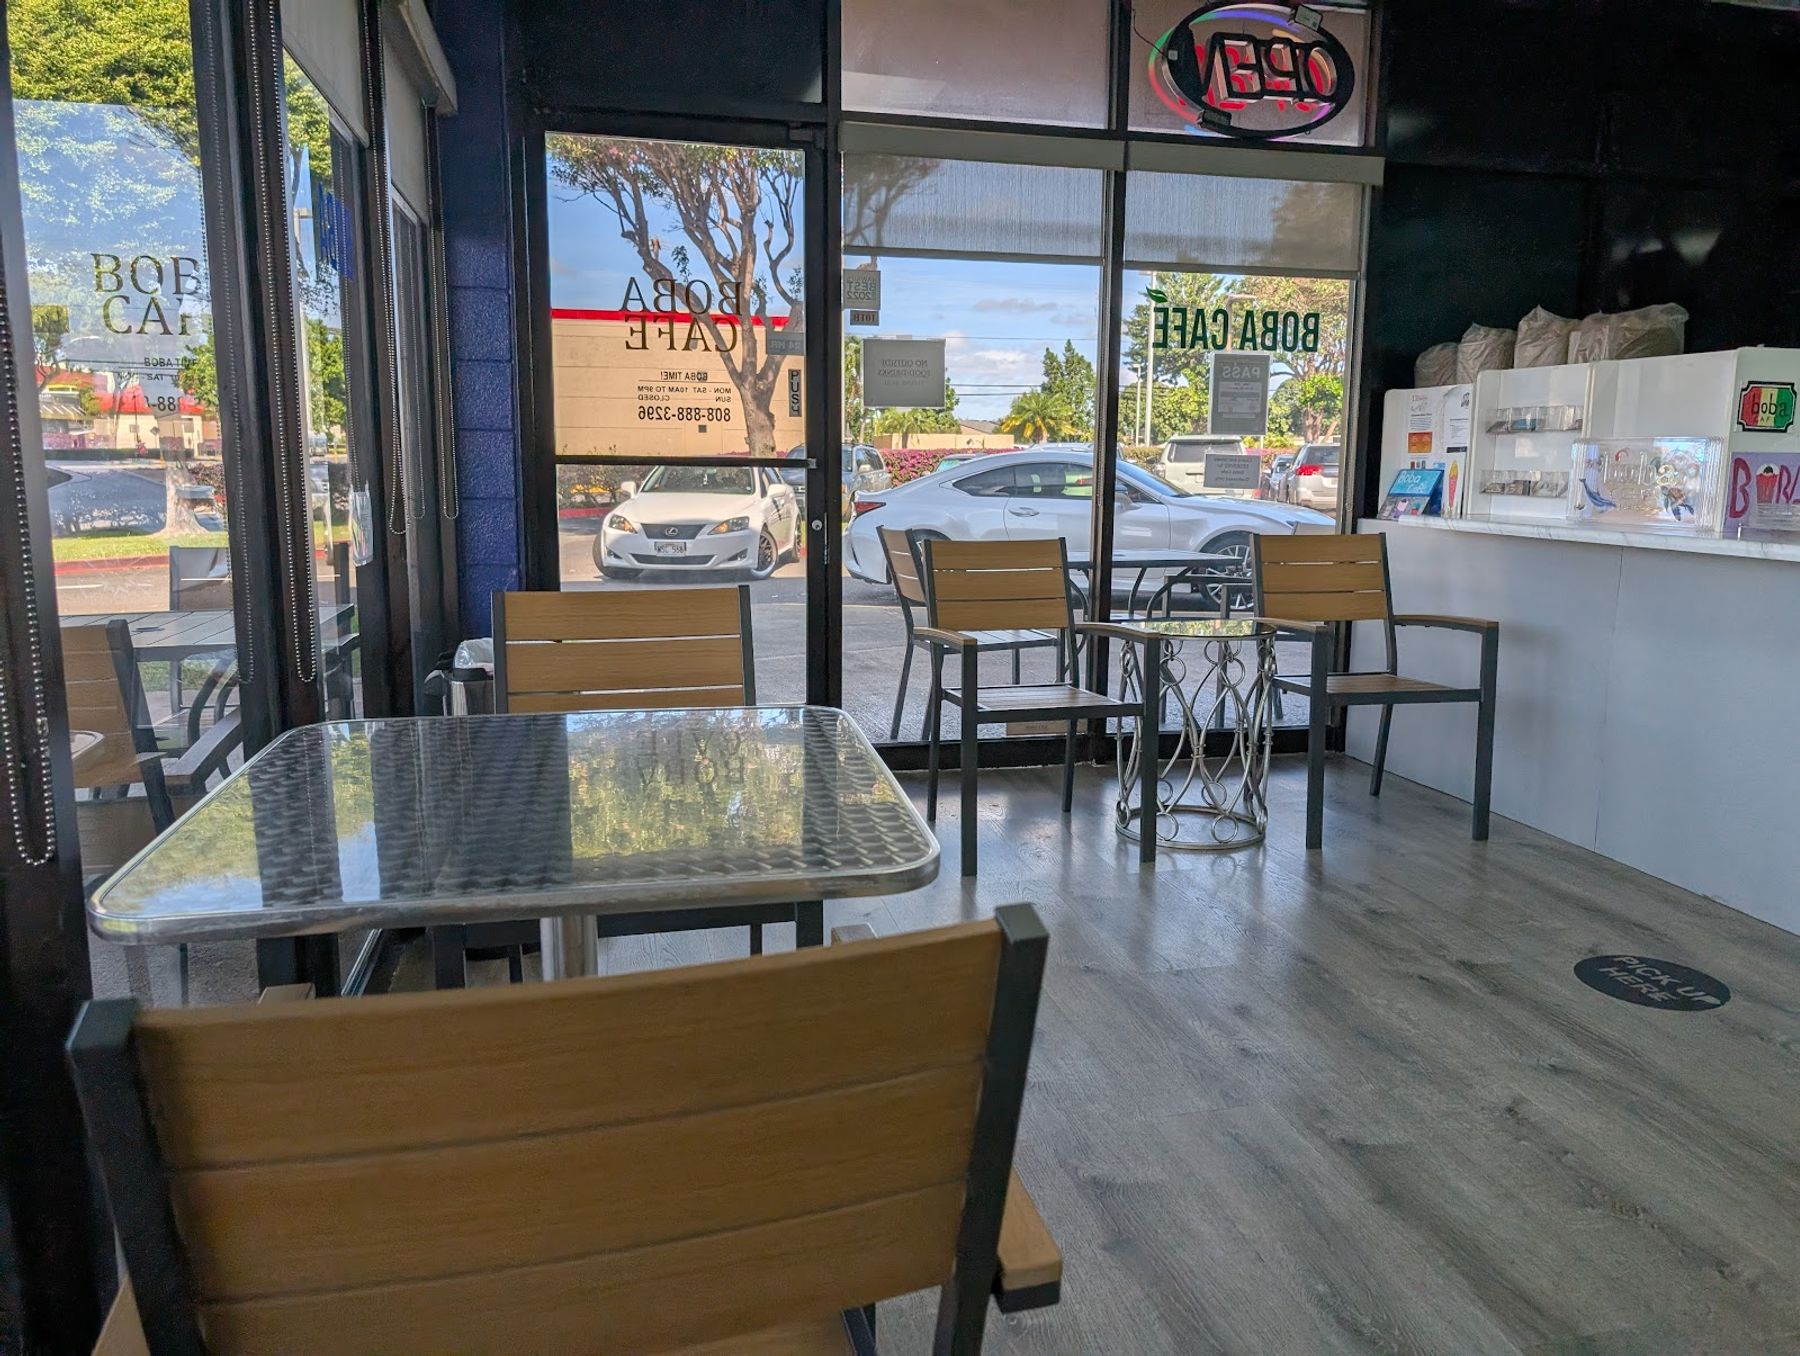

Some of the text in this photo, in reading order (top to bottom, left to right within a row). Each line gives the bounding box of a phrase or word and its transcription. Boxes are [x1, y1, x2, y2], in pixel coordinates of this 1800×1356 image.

[90, 252, 203, 296] BOB
[1751, 392, 1788, 418] boba
[1598, 966, 1678, 1003] HERE
[1613, 956, 1681, 986] PICK
